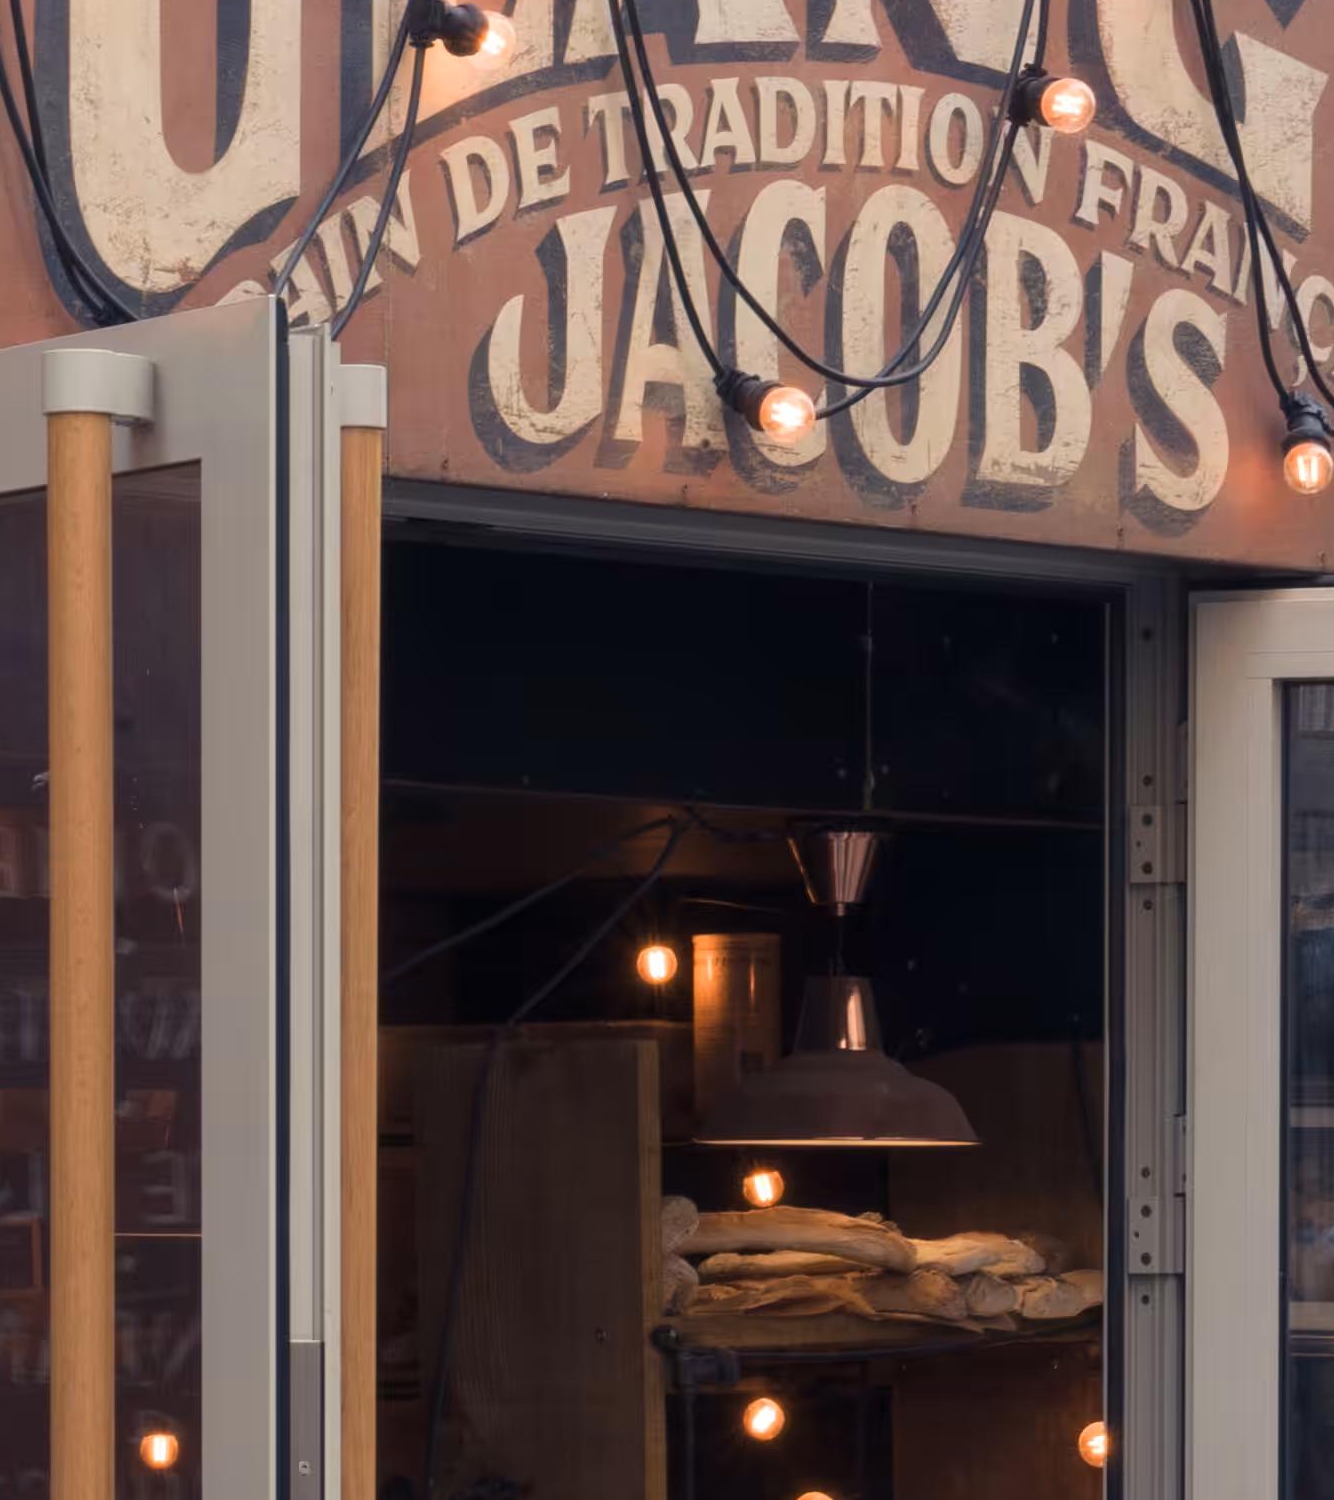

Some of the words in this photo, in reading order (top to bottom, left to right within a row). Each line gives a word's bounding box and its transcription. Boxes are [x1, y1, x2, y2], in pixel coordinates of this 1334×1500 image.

[215, 168, 423, 330] AIN
[437, 106, 572, 246] DE
[565, 76, 1056, 205] TRADITION
[479, 177, 1231, 522] JACOB'S
